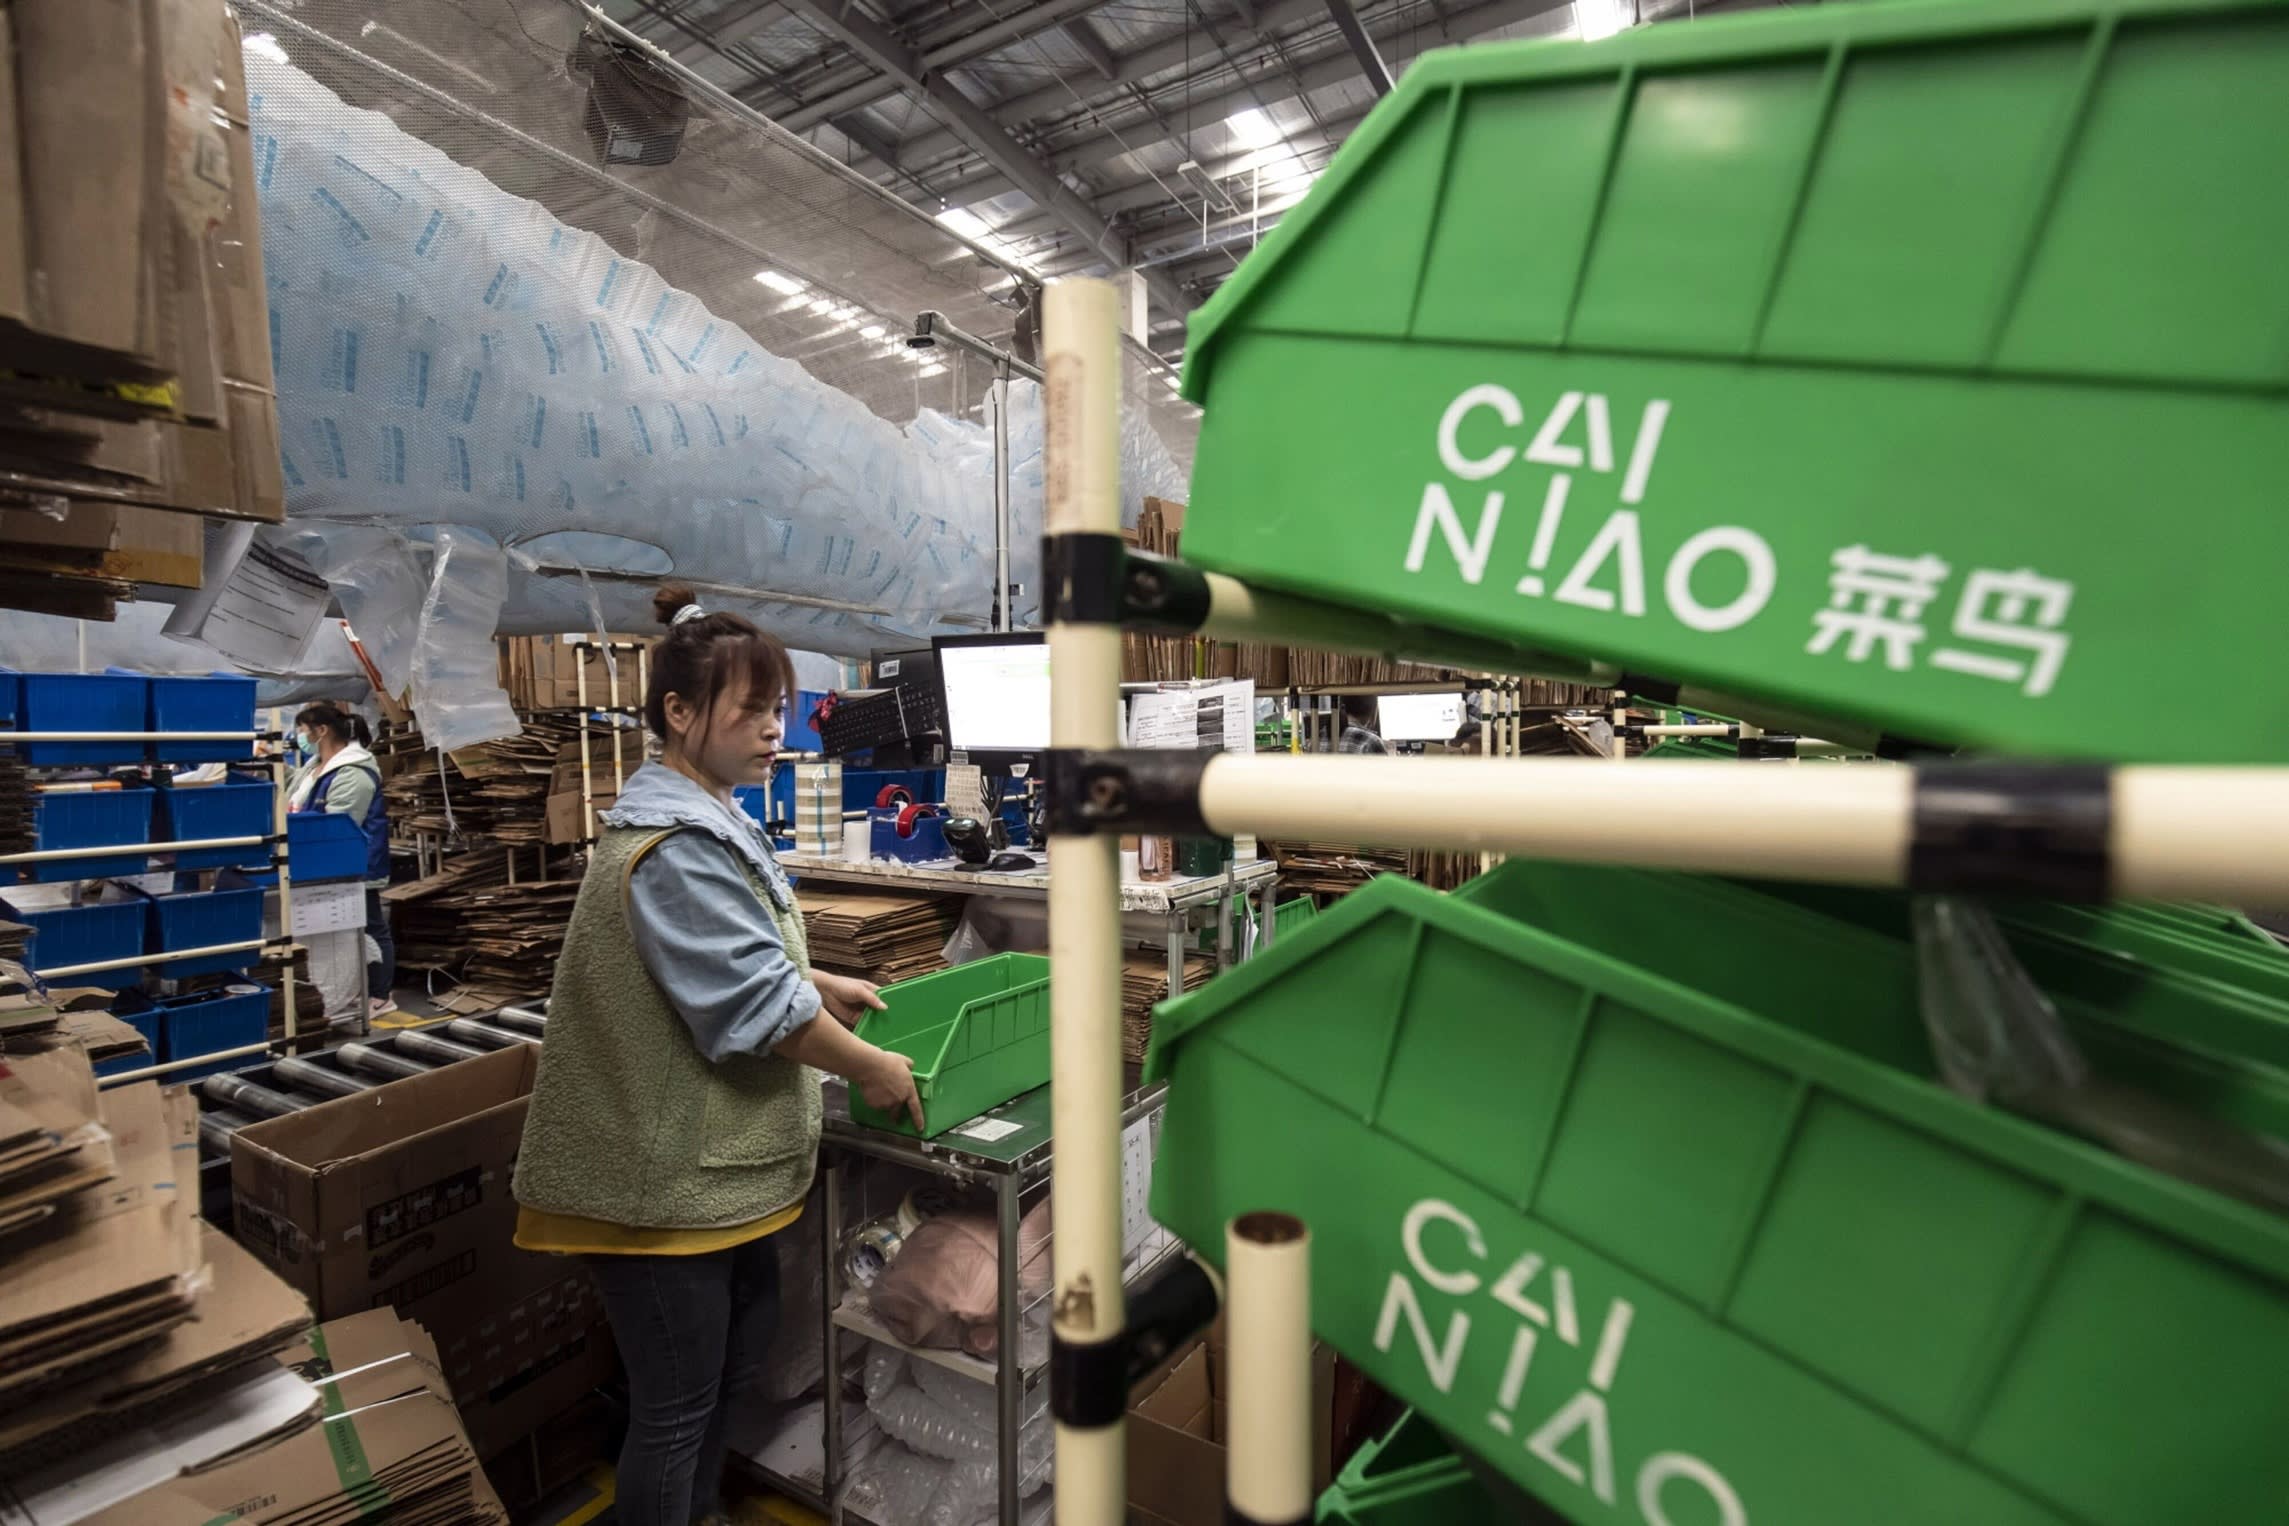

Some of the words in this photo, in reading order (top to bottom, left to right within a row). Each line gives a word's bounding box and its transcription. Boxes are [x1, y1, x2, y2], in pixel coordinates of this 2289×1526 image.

[1437, 383, 1671, 504] CAI
[1805, 544, 2074, 696] 菜鸟
[1402, 1198, 1635, 1392] CAI
